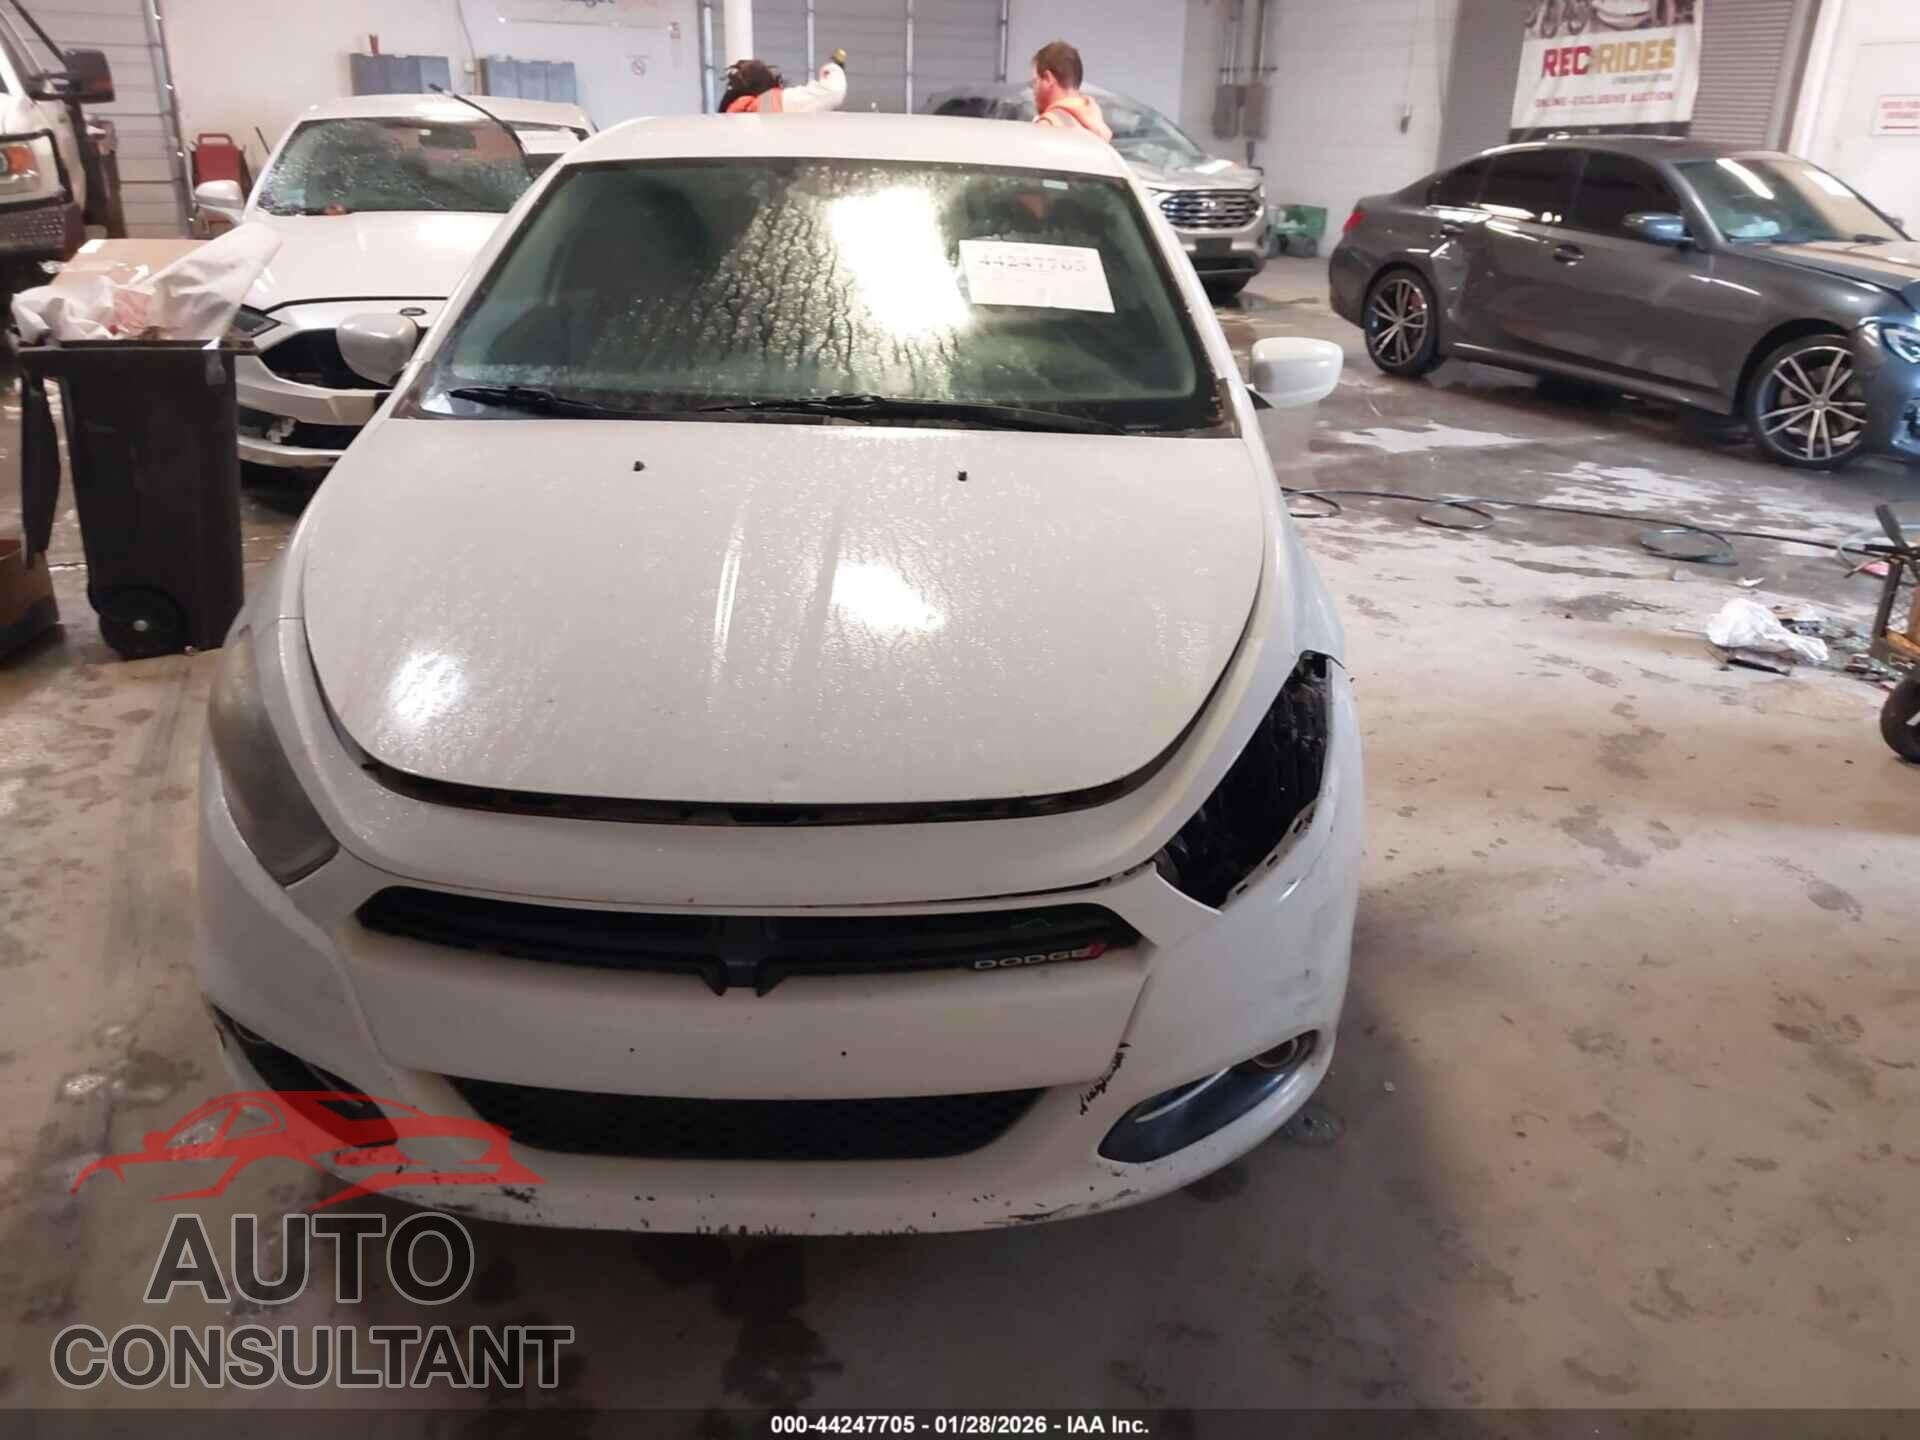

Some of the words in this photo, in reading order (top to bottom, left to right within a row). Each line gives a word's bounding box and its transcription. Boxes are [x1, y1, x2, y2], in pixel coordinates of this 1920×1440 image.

[1541, 46, 1592, 79] REC
[1597, 38, 1676, 73] RIDES
[974, 948, 1091, 970] DODGE
